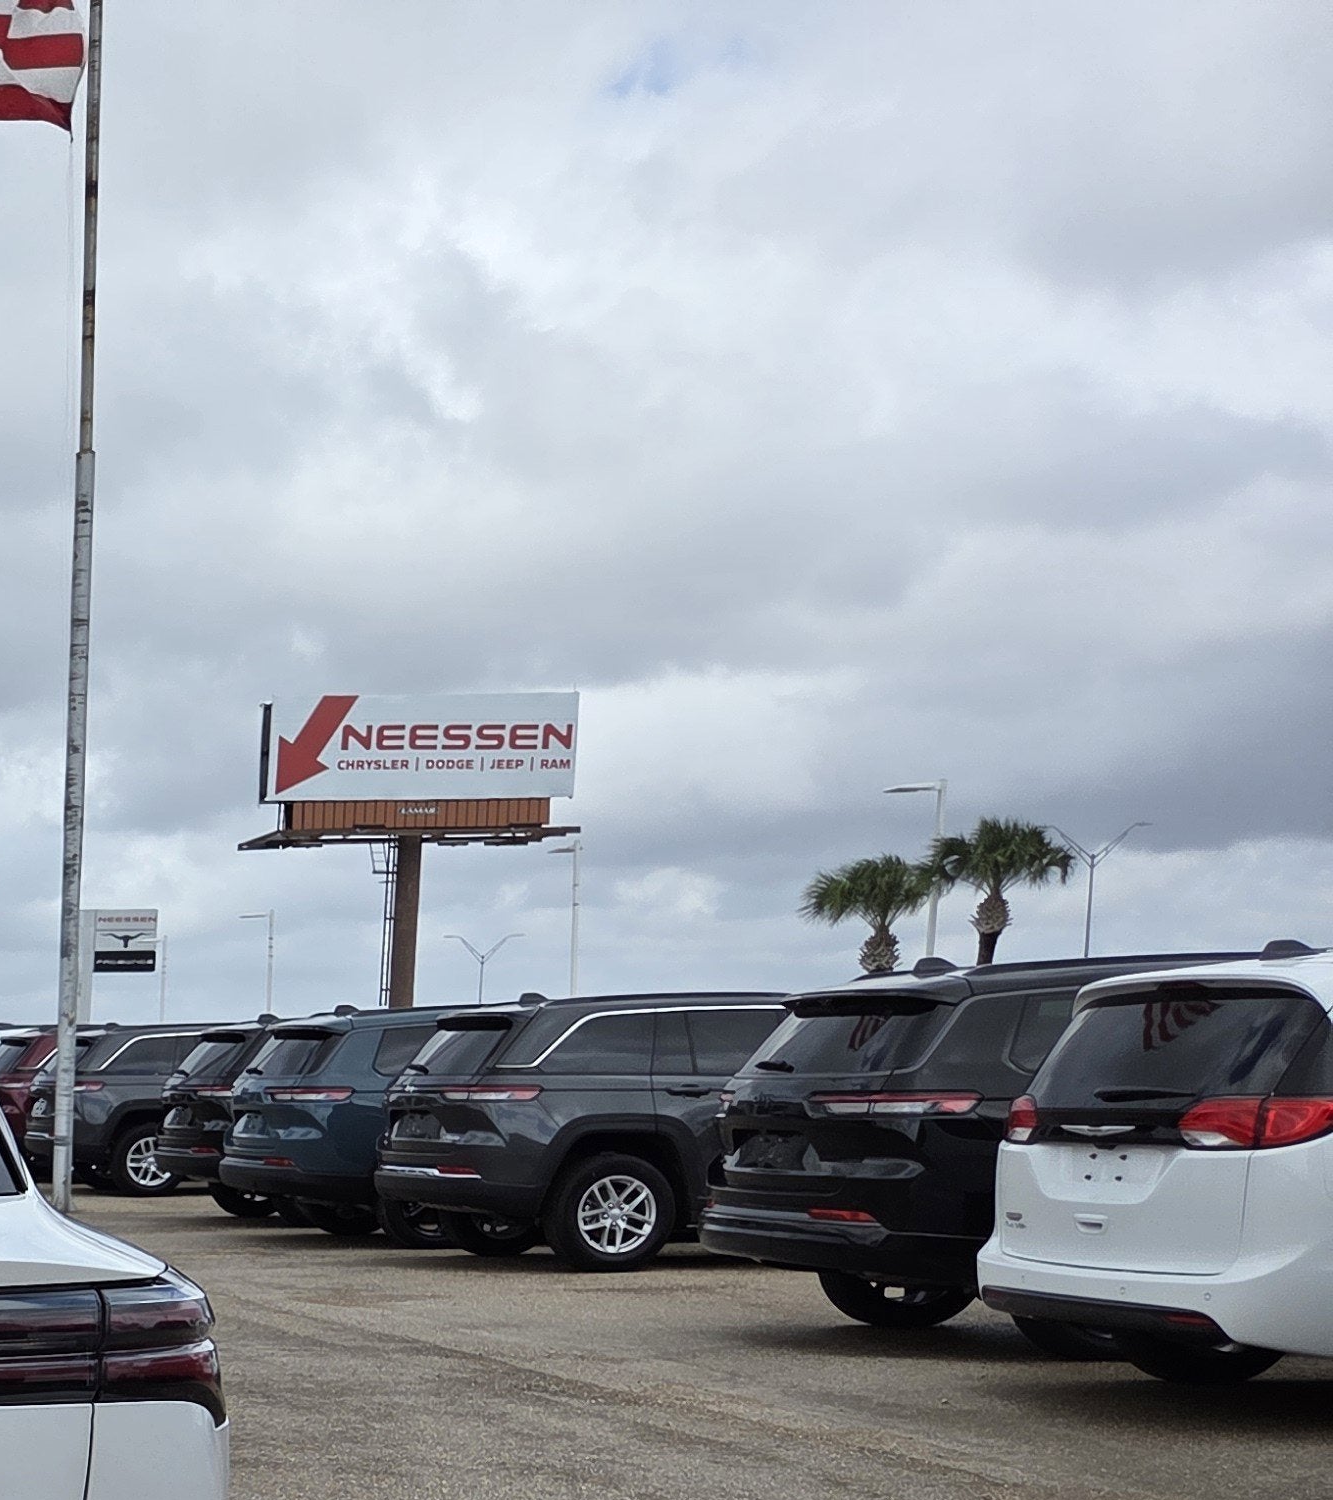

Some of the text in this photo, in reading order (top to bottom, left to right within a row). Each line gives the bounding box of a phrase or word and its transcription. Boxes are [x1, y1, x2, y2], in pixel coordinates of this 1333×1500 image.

[341, 724, 573, 750] NEESSEN
[337, 759, 571, 770] CHRYSLER DODGE JEEP RAM
